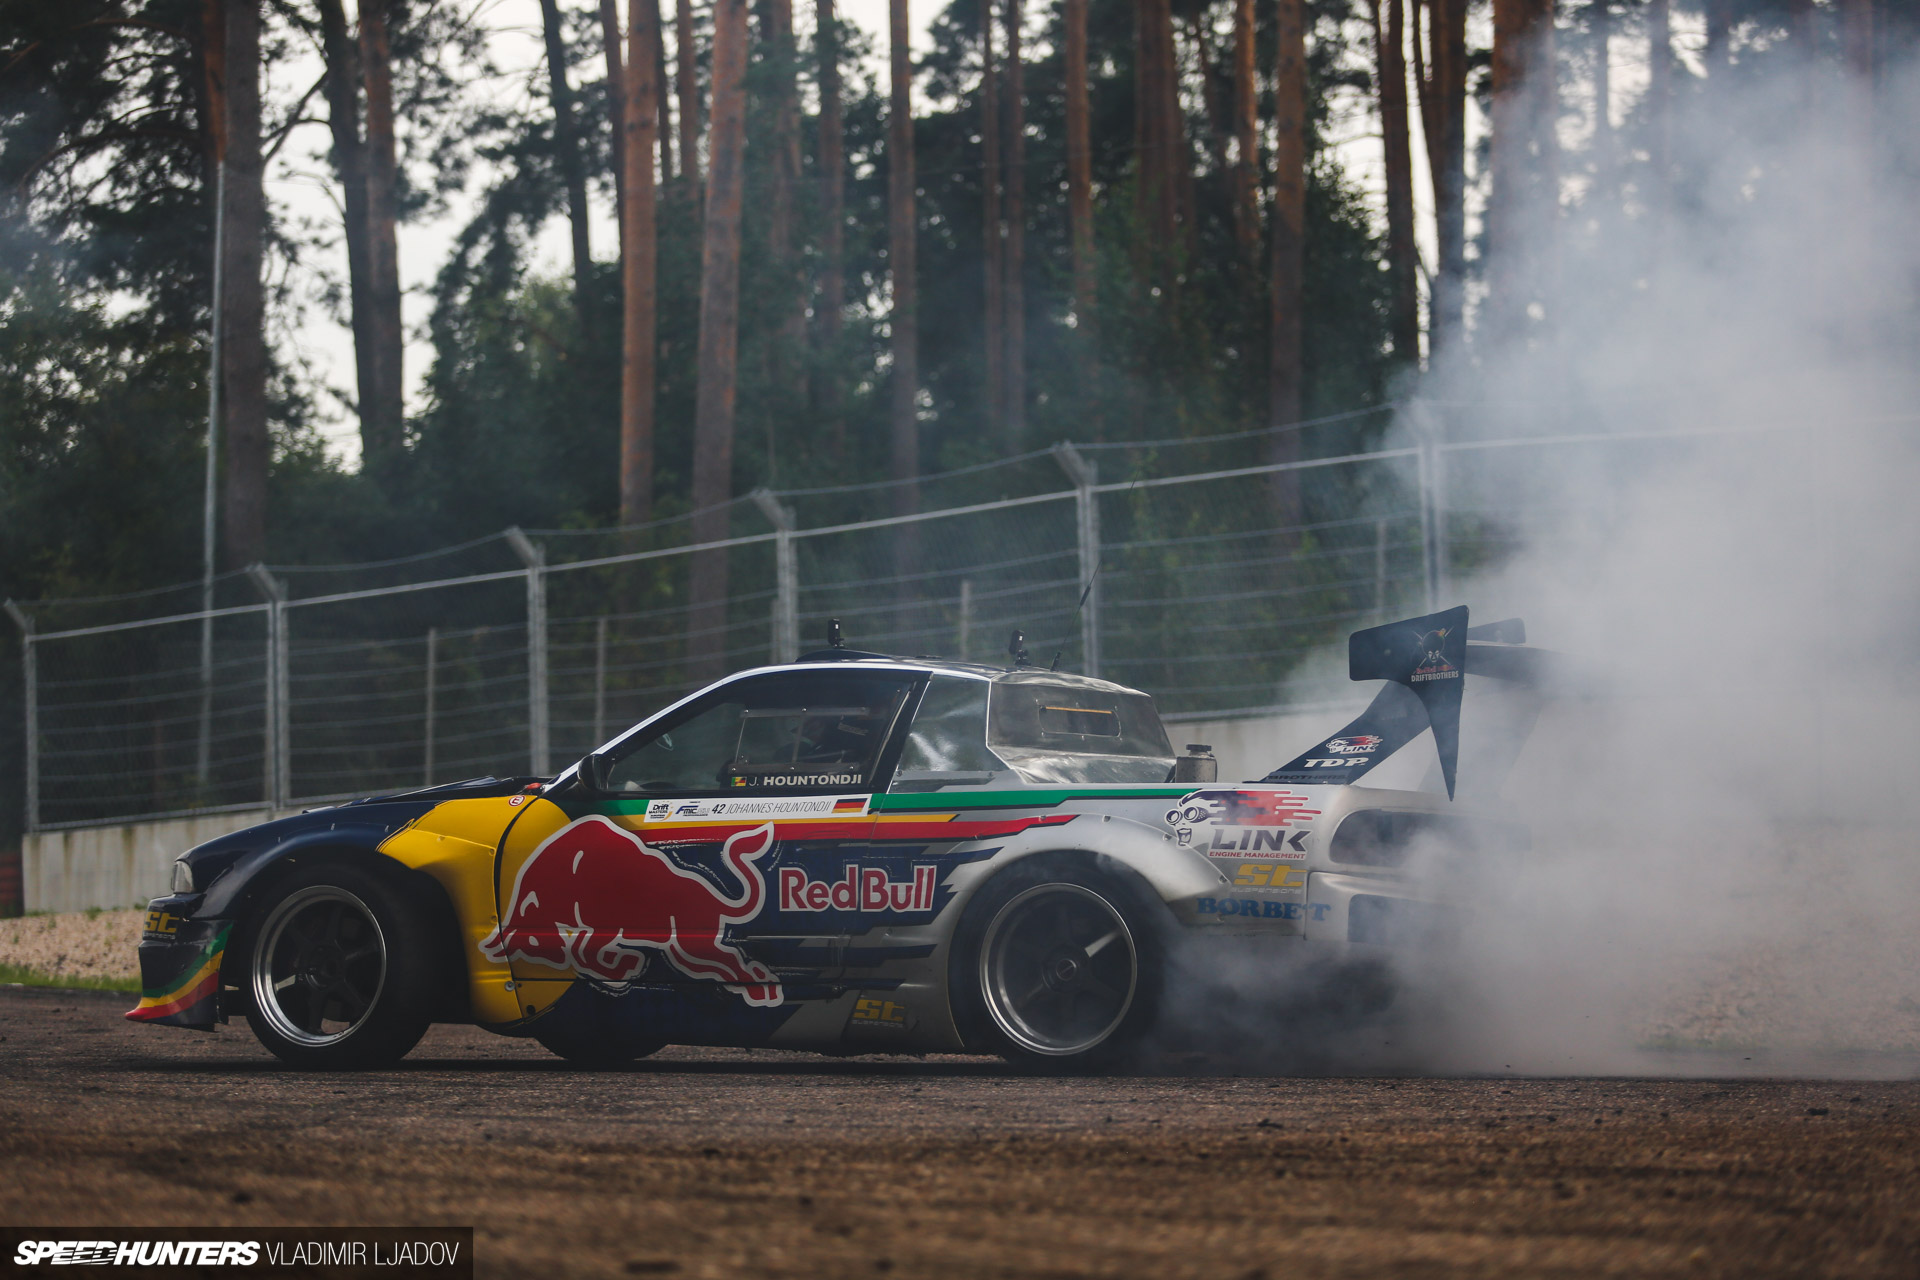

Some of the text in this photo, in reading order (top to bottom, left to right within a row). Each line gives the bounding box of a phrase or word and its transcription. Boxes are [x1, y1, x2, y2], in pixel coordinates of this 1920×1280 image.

[1411, 671, 1459, 682] DRIFTBROTHERS
[748, 774, 862, 787] J. HOUNTONDJI
[711, 803, 726, 814] 42
[725, 802, 774, 815] JOHANNES
[773, 801, 831, 813] HOUNTONDJI
[1211, 828, 1312, 852] LINK
[1244, 852, 1306, 860] MANAGEMENT
[779, 864, 937, 912] Red Bull
[1196, 897, 1332, 922] BORBET
